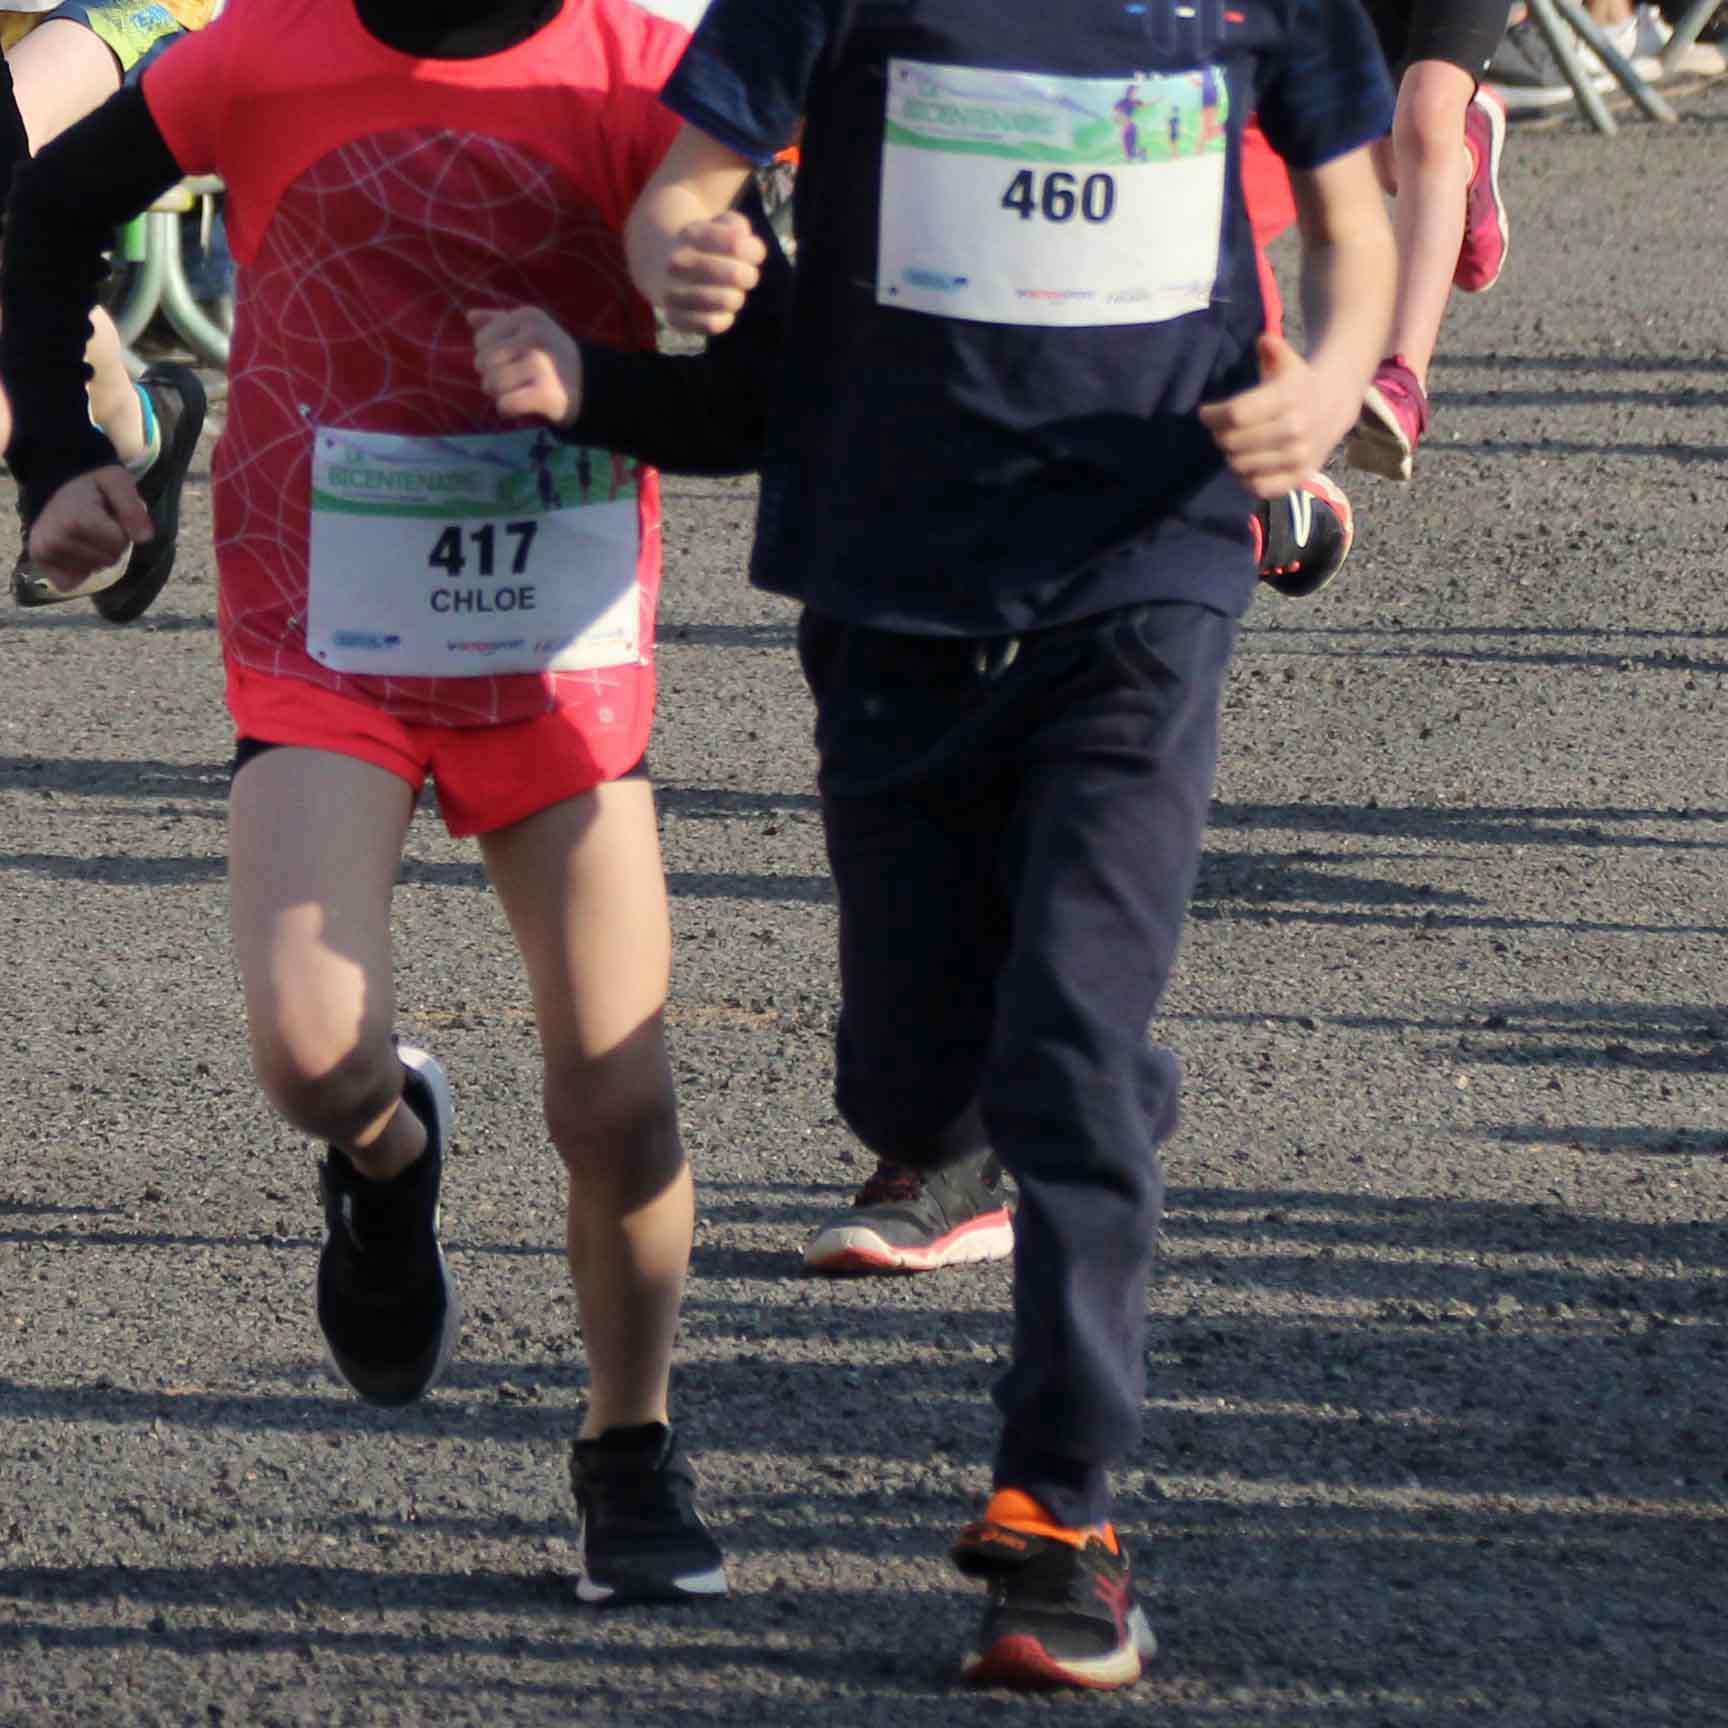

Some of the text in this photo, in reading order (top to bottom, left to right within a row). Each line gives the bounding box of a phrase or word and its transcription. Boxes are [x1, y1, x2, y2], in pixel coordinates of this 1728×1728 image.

[1000, 168, 1115, 223] 460
[428, 521, 539, 577] 417
[429, 585, 536, 614] CHLOE
